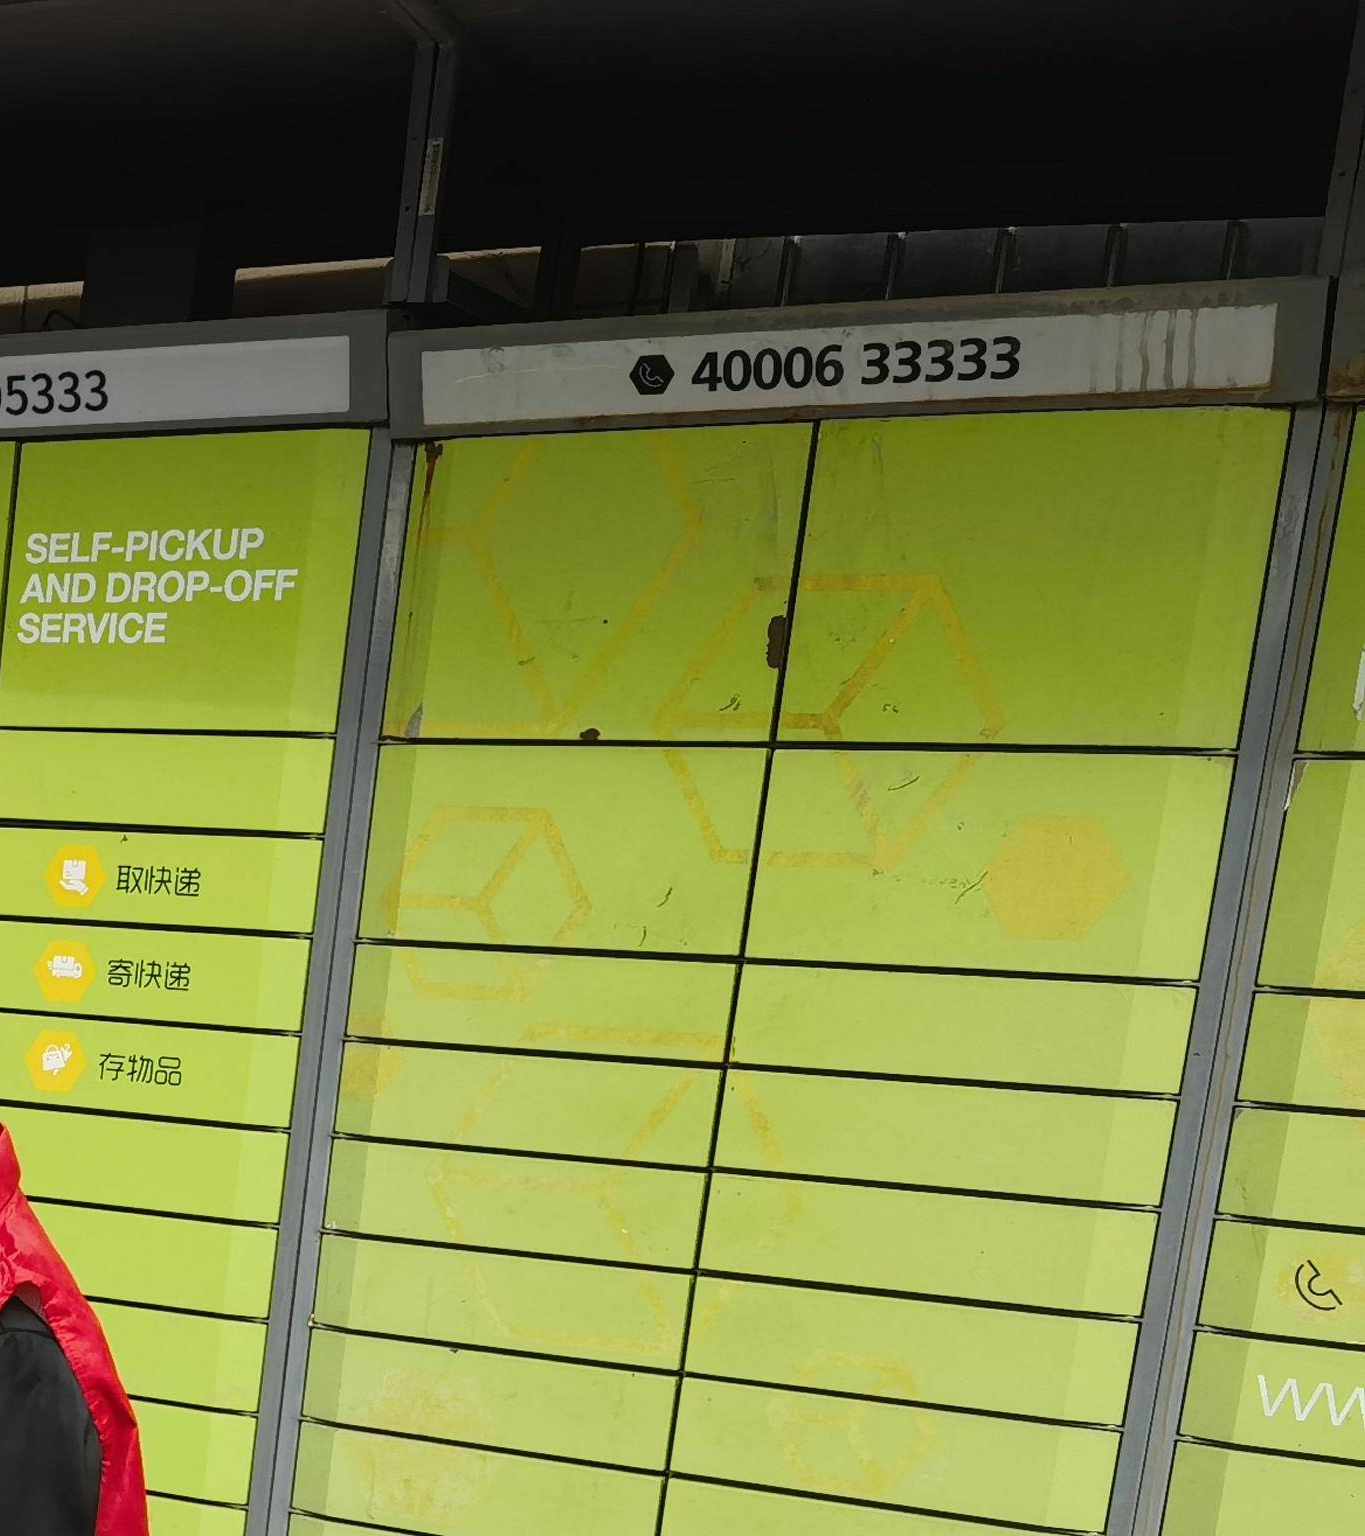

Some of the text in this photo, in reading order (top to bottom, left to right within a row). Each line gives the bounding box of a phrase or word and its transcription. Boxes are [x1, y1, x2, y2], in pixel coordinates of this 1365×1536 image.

[691, 335, 1021, 392] 40006 33333
[25, 527, 265, 564] SELF-PICKUP
[20, 569, 299, 604] AND DROP-OFF
[17, 612, 168, 645] SERVICE
[116, 864, 202, 898] 取快递
[107, 958, 192, 992] 寄快递
[98, 1052, 182, 1087] 存物品
